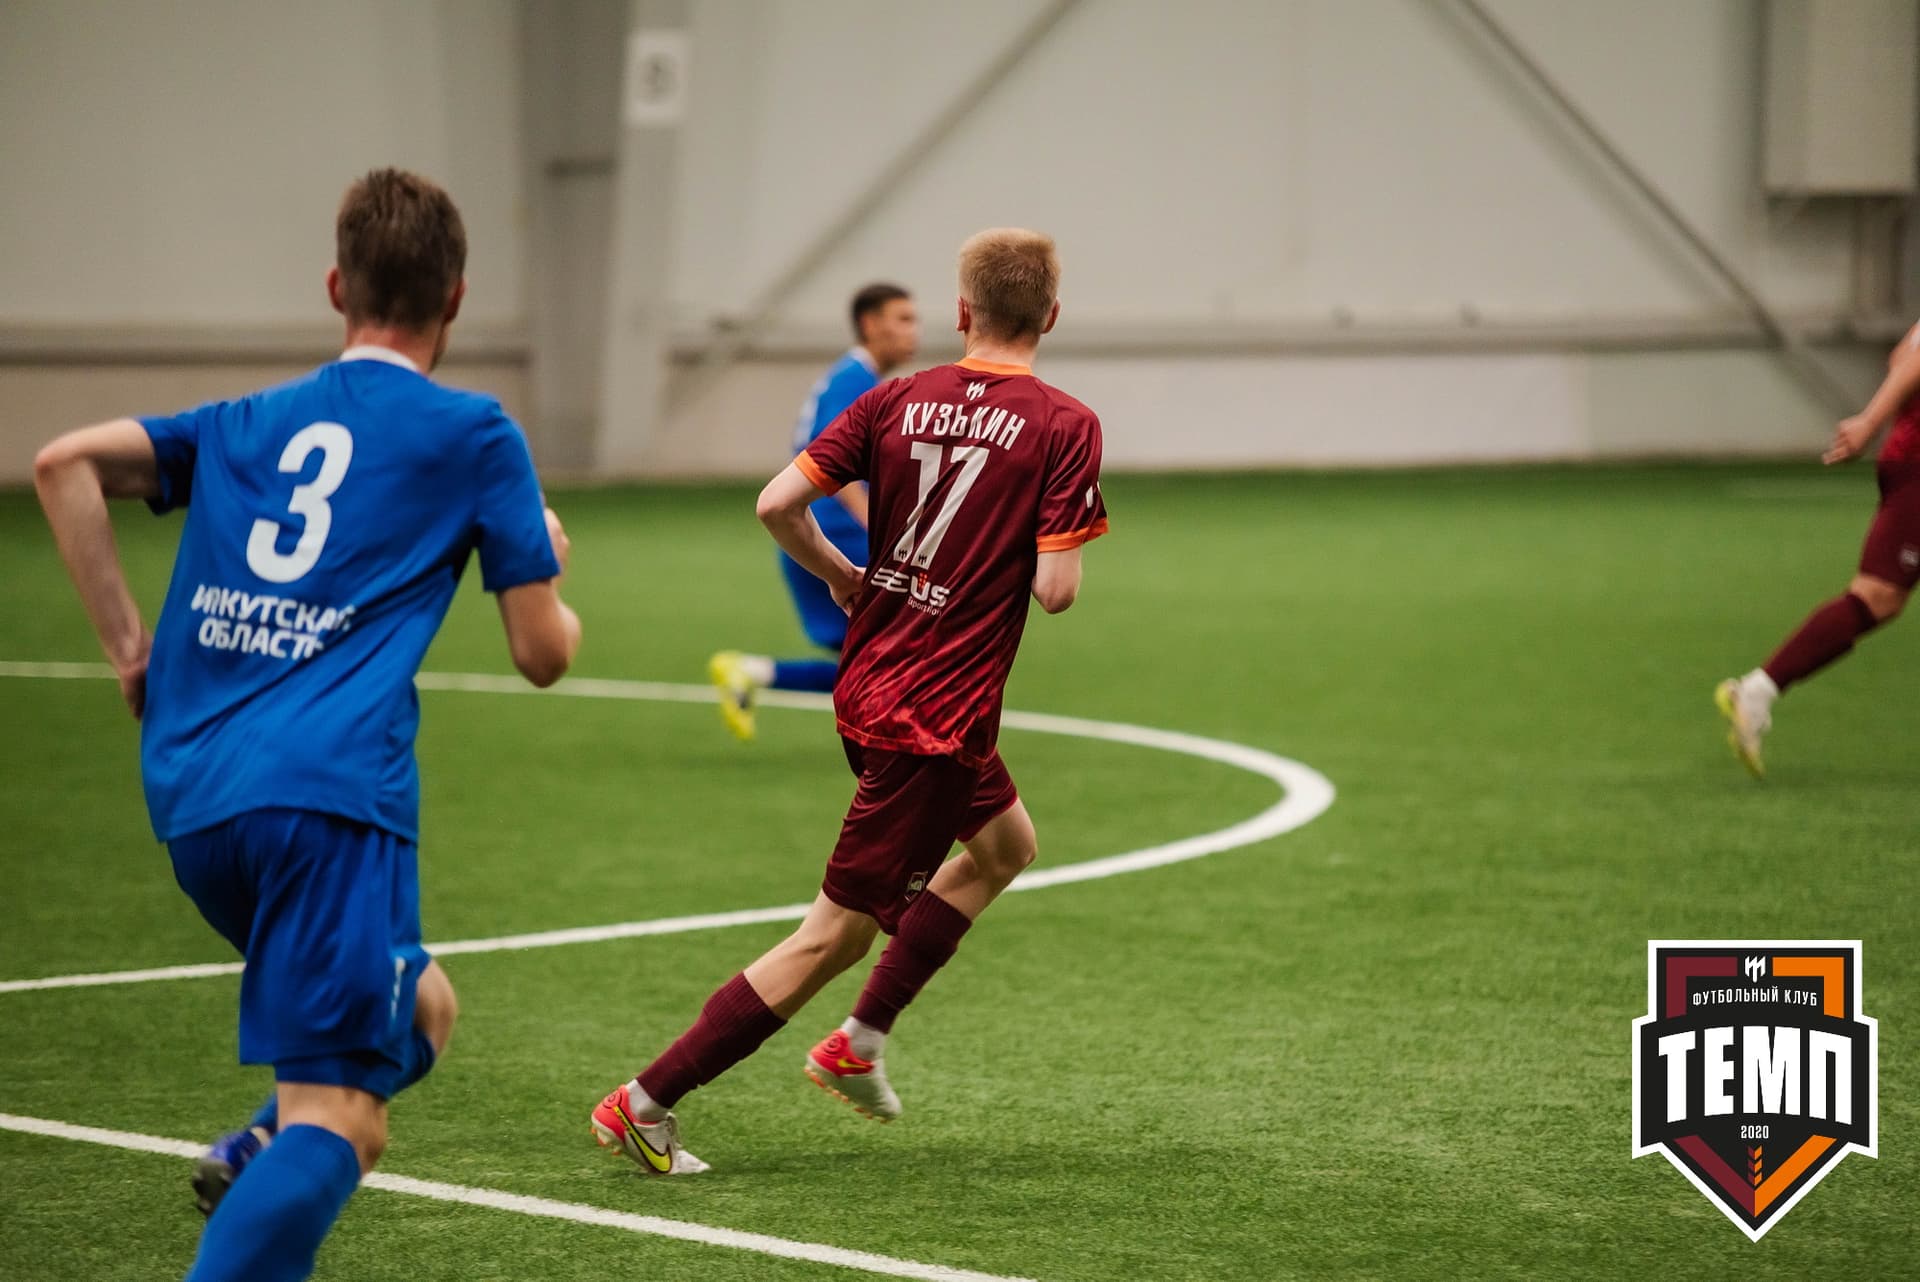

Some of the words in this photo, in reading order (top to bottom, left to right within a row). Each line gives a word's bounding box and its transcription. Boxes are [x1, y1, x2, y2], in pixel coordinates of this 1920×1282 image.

[901, 402, 1026, 450] КУЗЬКИН
[246, 421, 353, 583] 3
[893, 441, 990, 570] 17
